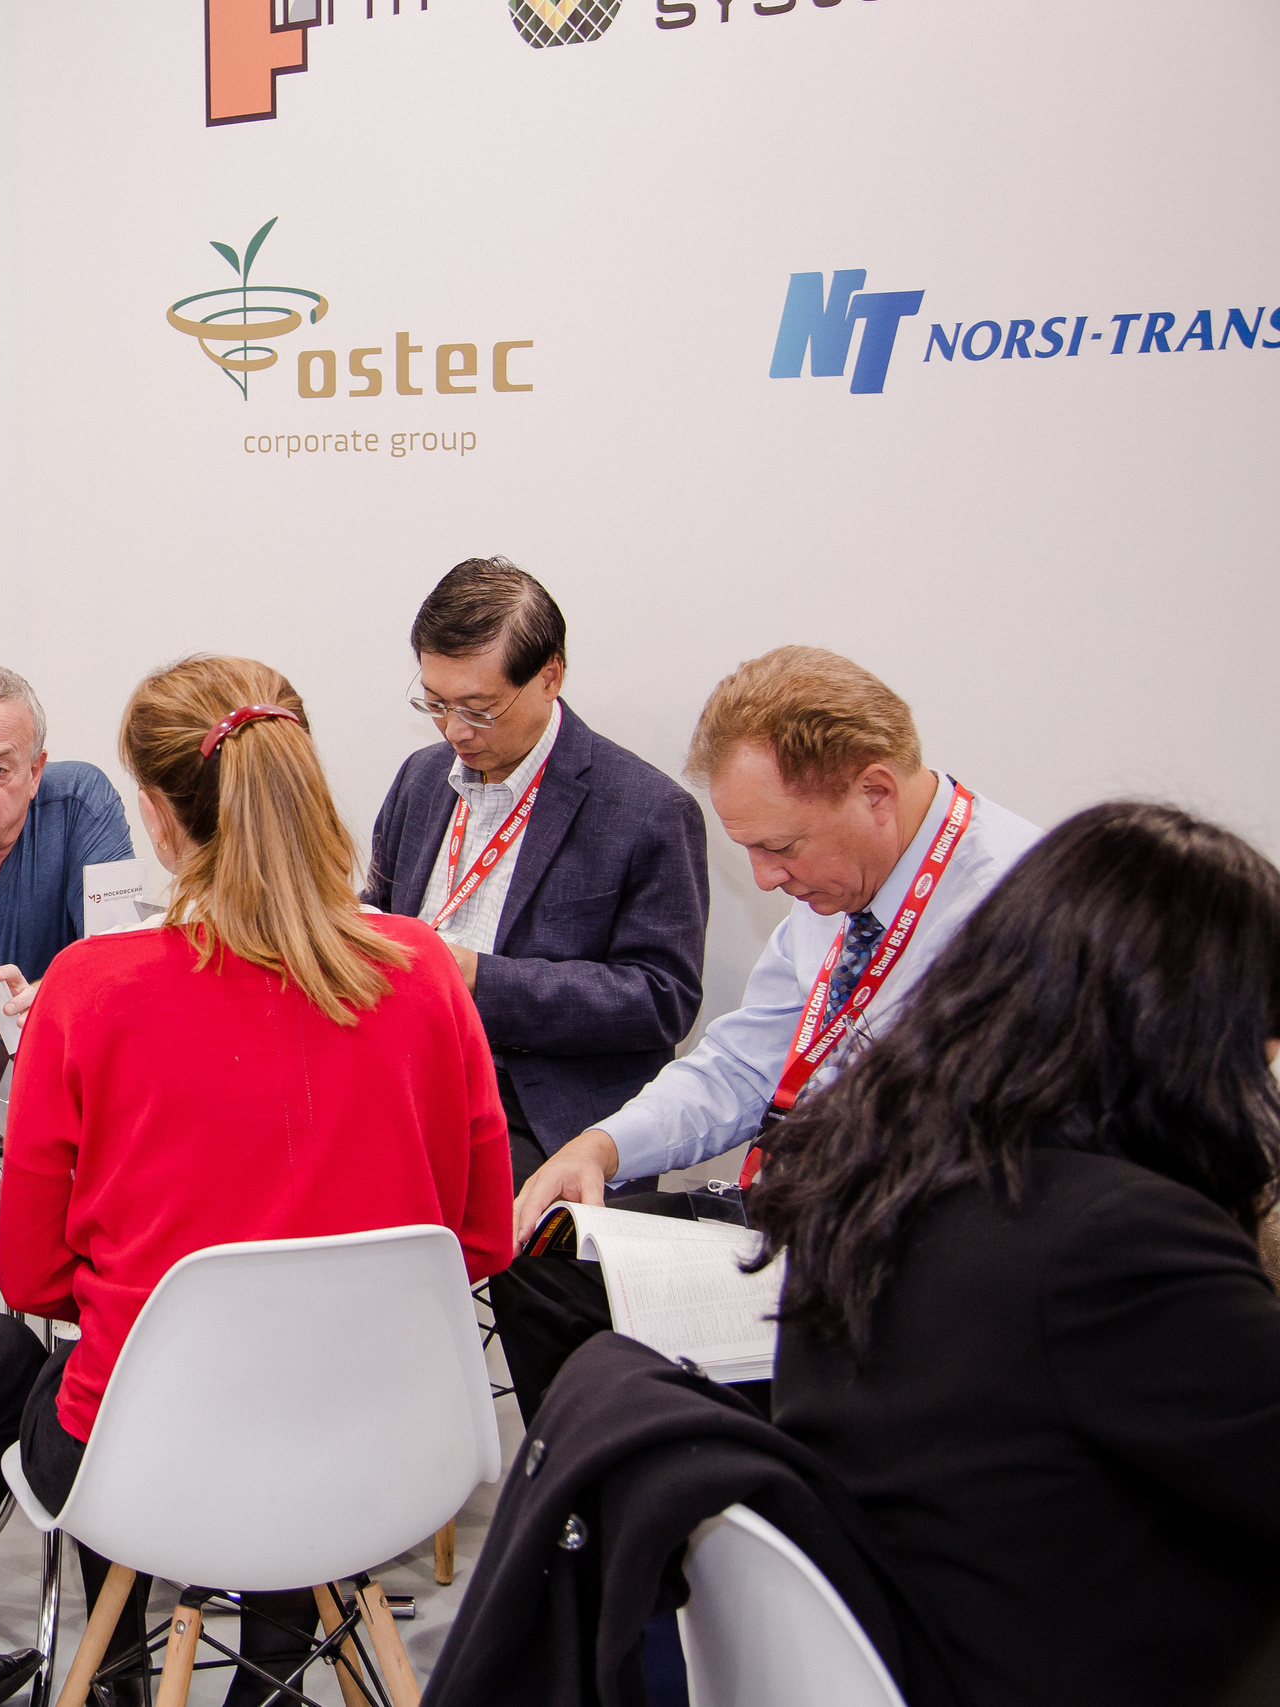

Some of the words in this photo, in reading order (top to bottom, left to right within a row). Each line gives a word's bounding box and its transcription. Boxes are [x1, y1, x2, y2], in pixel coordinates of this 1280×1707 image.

[297, 331, 534, 399] ostec
[243, 430, 380, 459] corporate
[389, 429, 478, 457] group
[455, 800, 468, 827] Stand
[499, 815, 523, 843] Stand
[930, 796, 968, 864] DIGIKEY.COM
[436, 871, 481, 922] DIGIKEY.COM
[870, 946, 897, 977] Stand
[888, 908, 917, 948] B5.165
[795, 981, 828, 1054] DIGIKEY.COM
